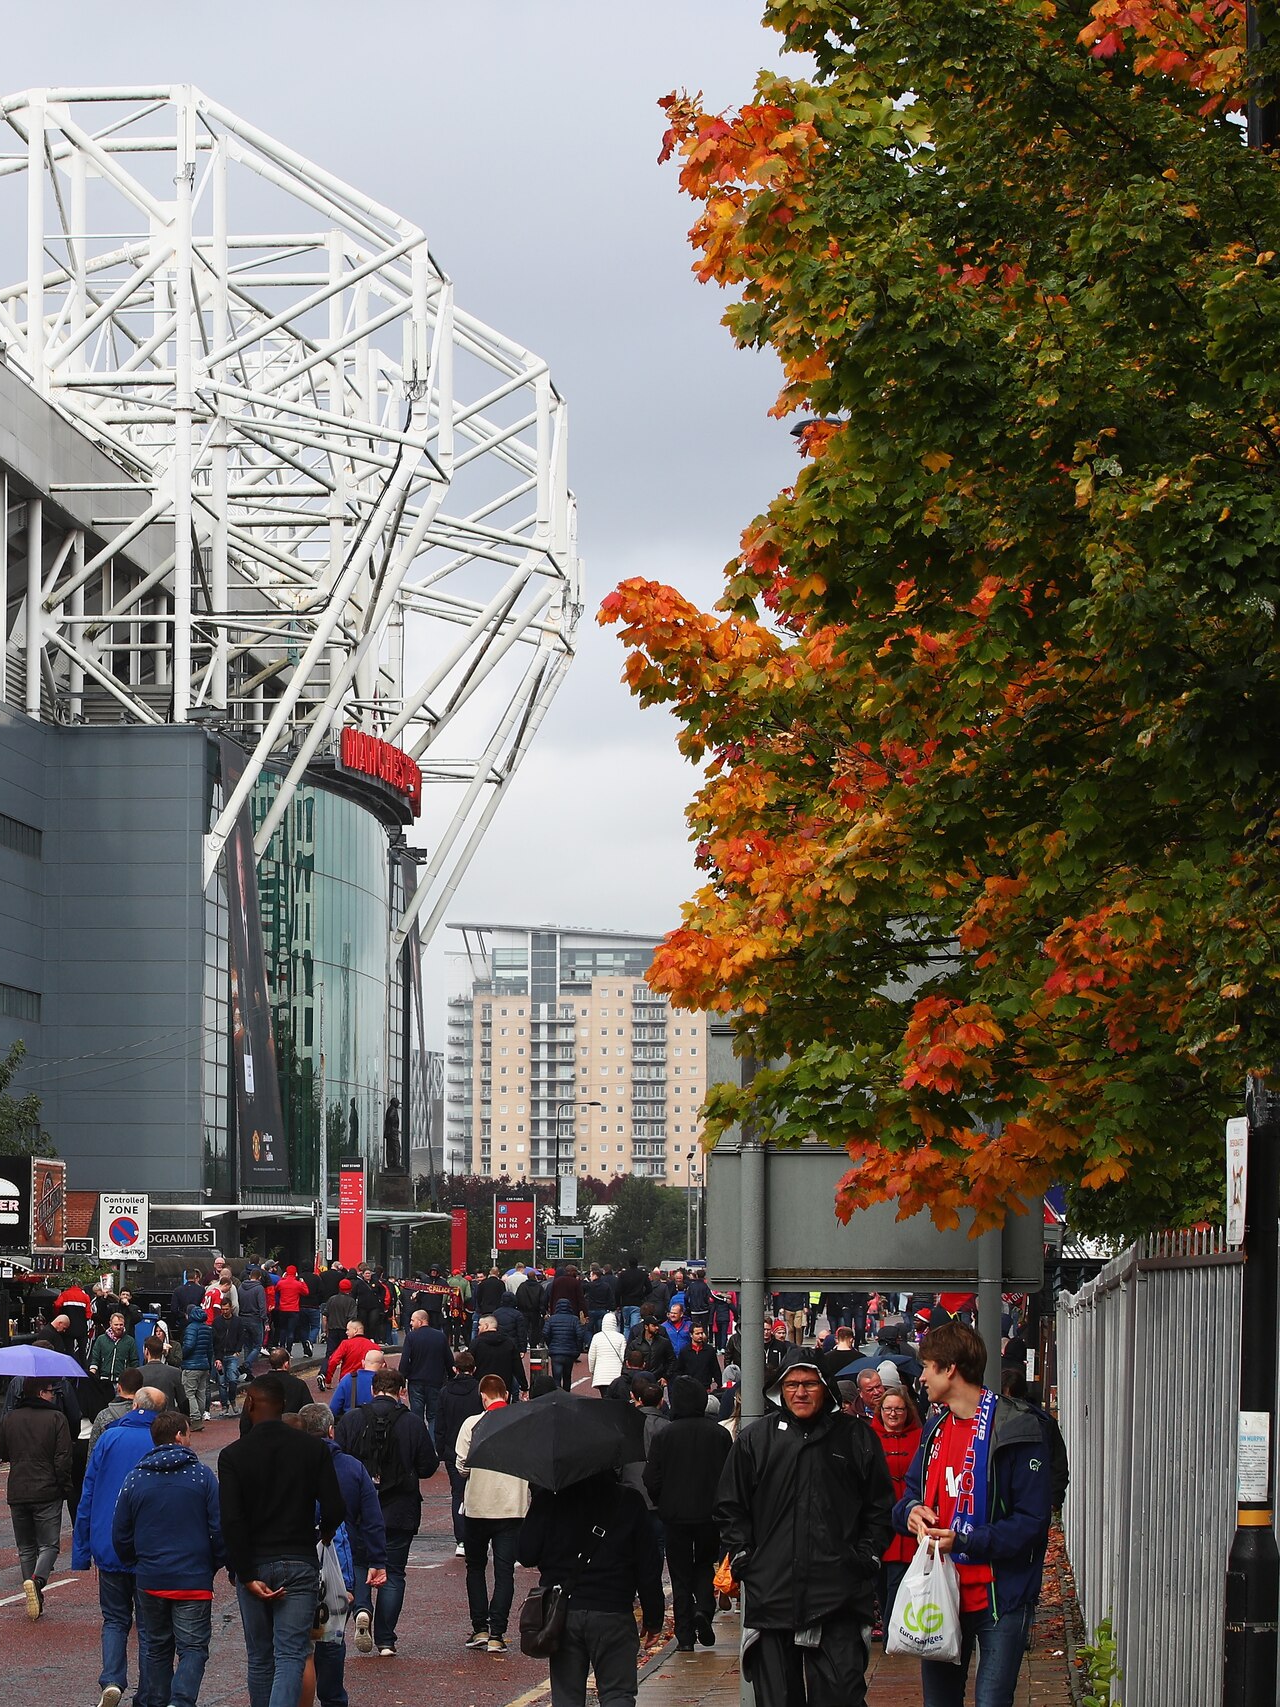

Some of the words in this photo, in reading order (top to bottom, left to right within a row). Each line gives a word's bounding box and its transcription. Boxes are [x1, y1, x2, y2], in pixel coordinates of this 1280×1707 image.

[103, 1196, 145, 1204] Controlled
[109, 1205, 139, 1214] ZONE
[978, 1404, 991, 1441] 17/18
[899, 1626, 914, 1641] Euro
